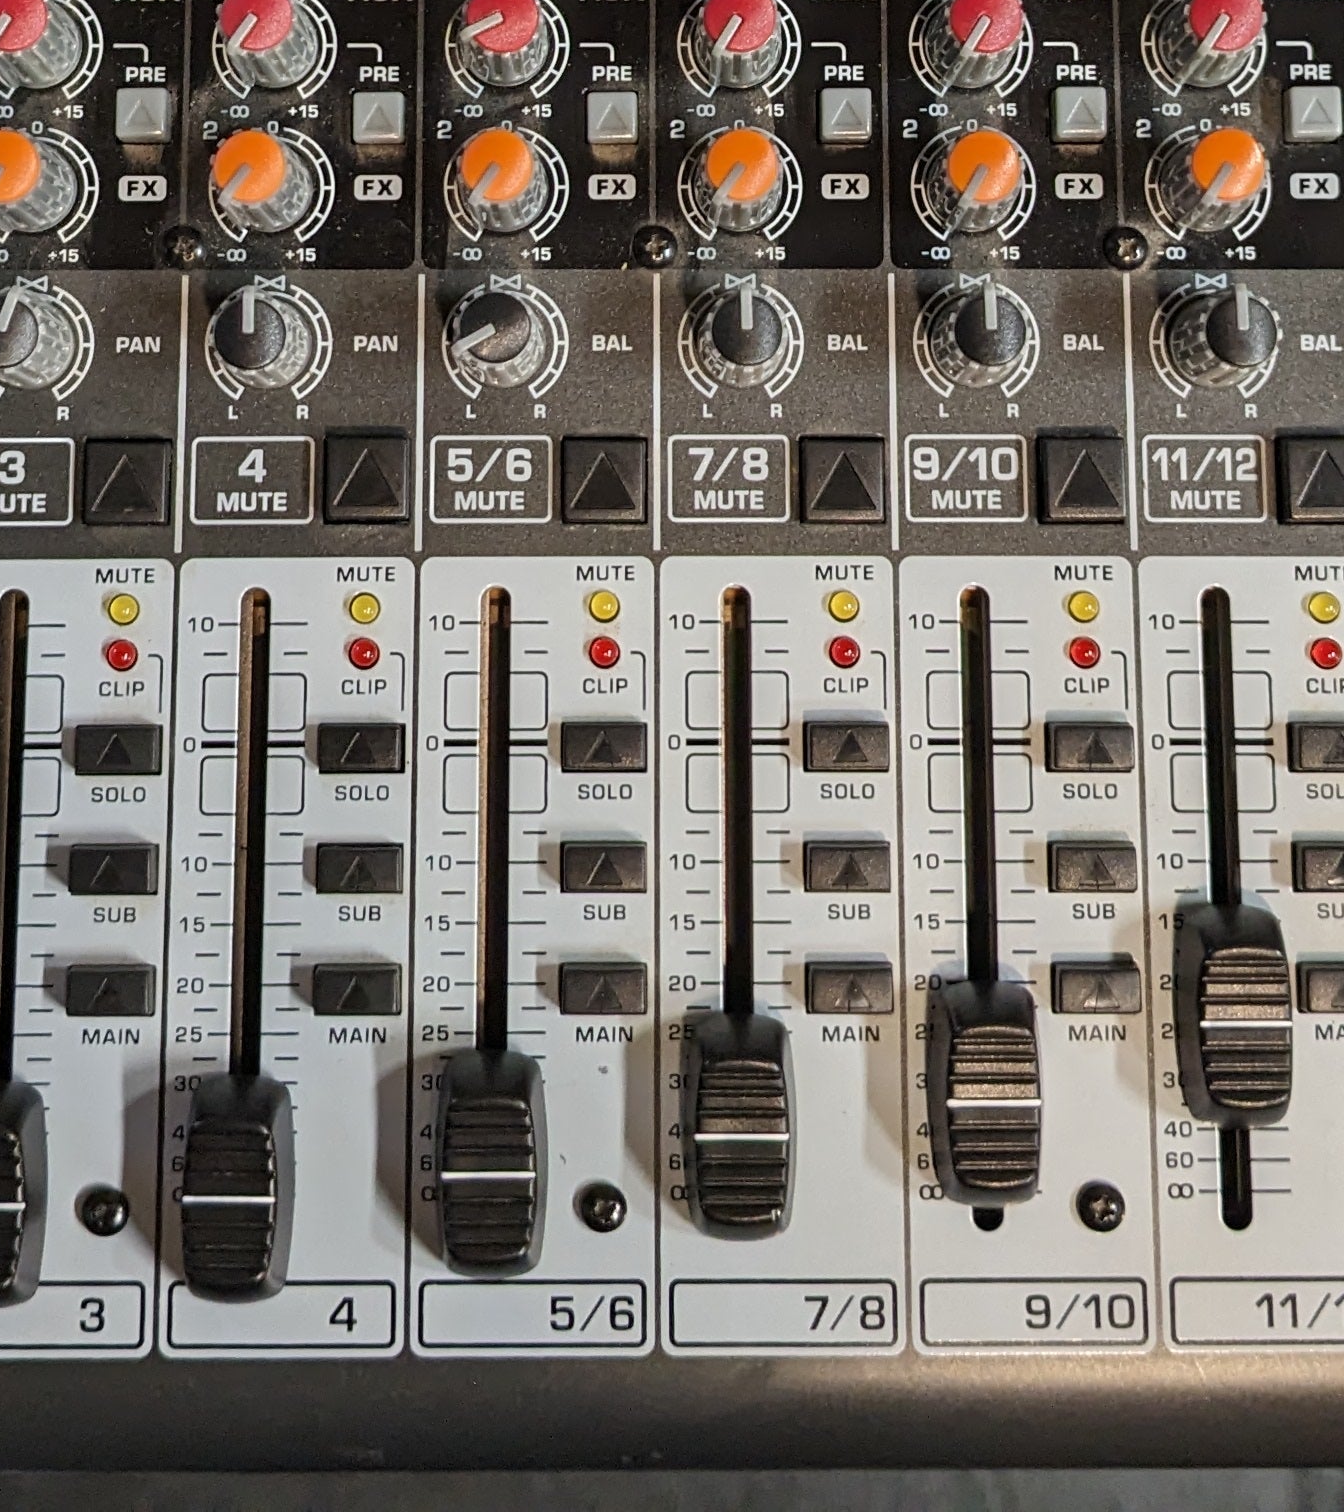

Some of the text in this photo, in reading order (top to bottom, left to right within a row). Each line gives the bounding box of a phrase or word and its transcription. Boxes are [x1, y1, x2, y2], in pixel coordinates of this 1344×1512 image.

[592, 65, 633, 82] PRE
[596, 178, 627, 195] FX
[1300, 334, 1343, 352] BAL
[447, 447, 532, 482] 5/6
[454, 490, 525, 511] MUTE
[576, 565, 635, 581] MUTE
[823, 677, 869, 694] CLIP
[820, 783, 875, 800] SOLO
[827, 903, 871, 920] SUB
[822, 1024, 881, 1043] MAIN
[329, 1297, 358, 1332] 4
[550, 1295, 635, 1332] 5/6
[804, 1295, 886, 1331] 7/8
[1025, 1294, 1136, 1330] 9/10
